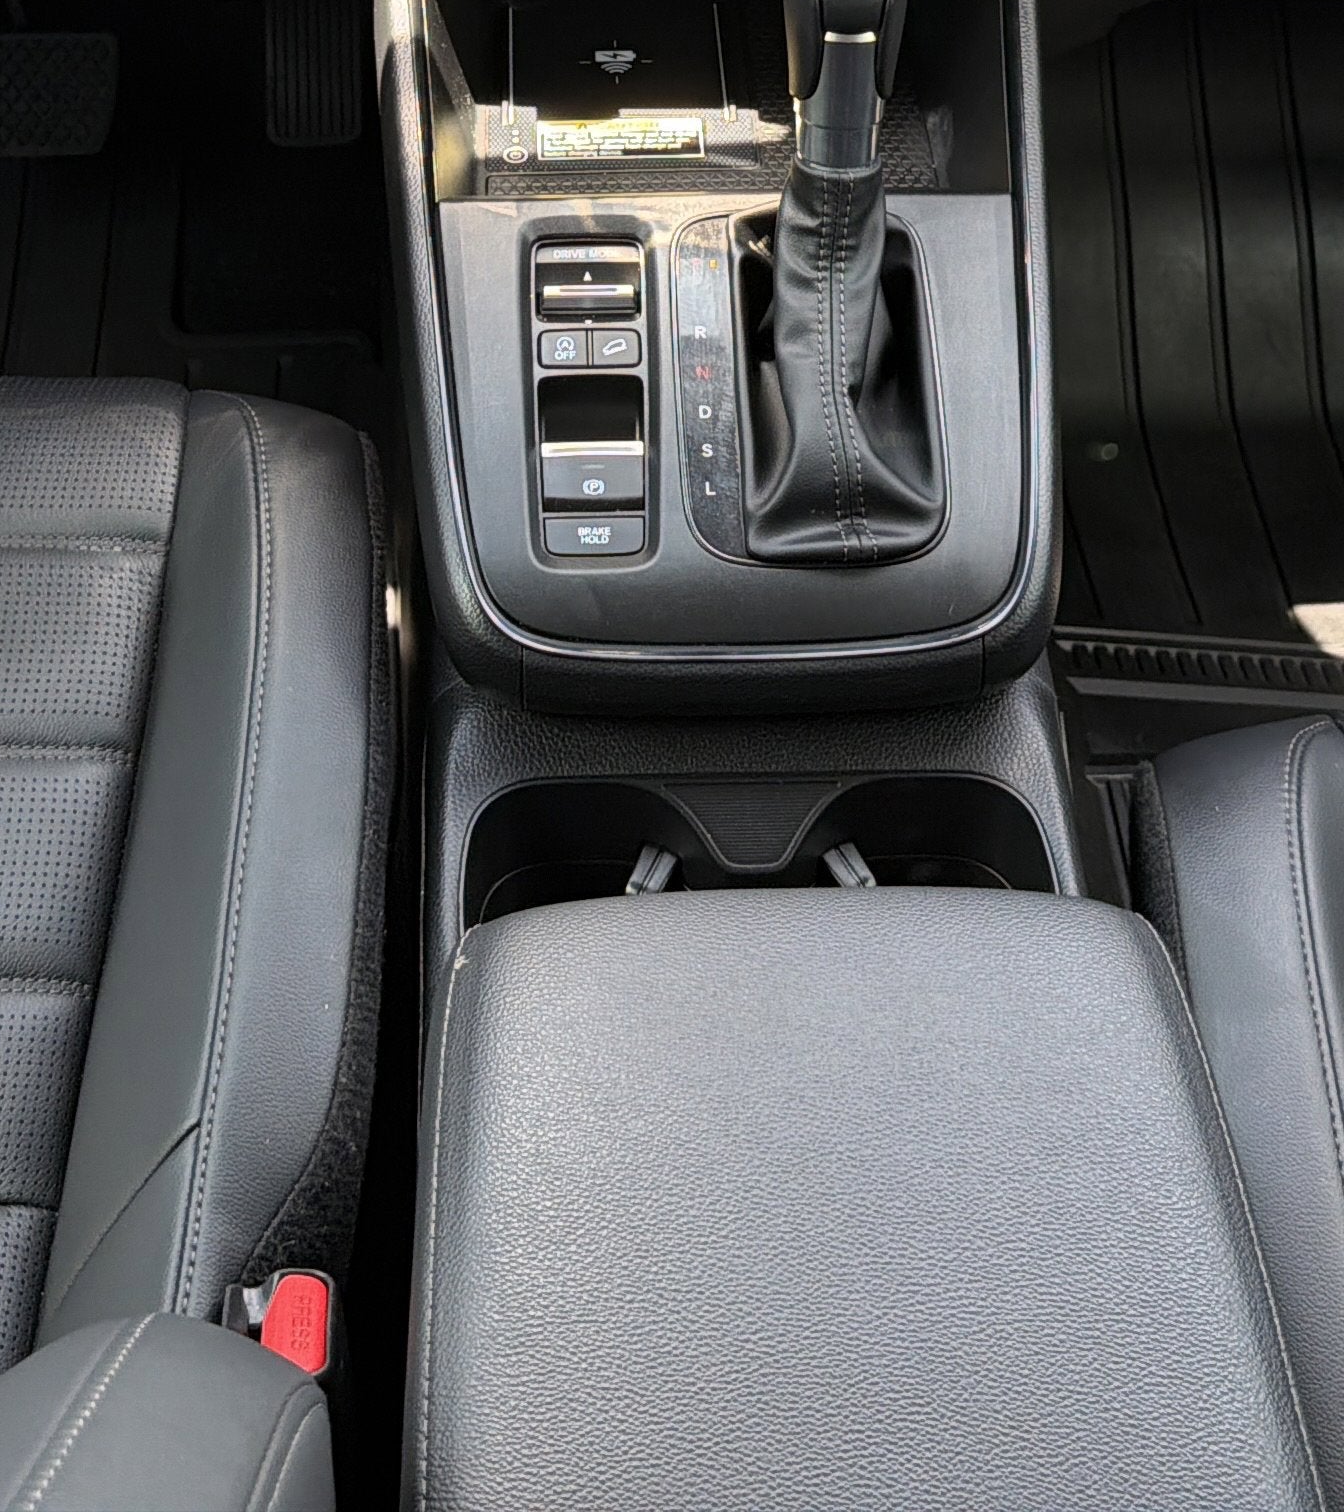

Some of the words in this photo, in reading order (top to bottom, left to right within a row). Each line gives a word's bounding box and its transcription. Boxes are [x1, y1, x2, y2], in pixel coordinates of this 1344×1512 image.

[552, 248, 586, 259] DRIVE
[694, 325, 707, 339] R
[554, 350, 577, 361] OFF
[696, 365, 711, 380] N
[698, 404, 712, 419] D
[701, 443, 714, 458] S
[705, 481, 716, 495] L
[577, 526, 612, 537] BRAKE
[580, 535, 610, 545] HOLD
